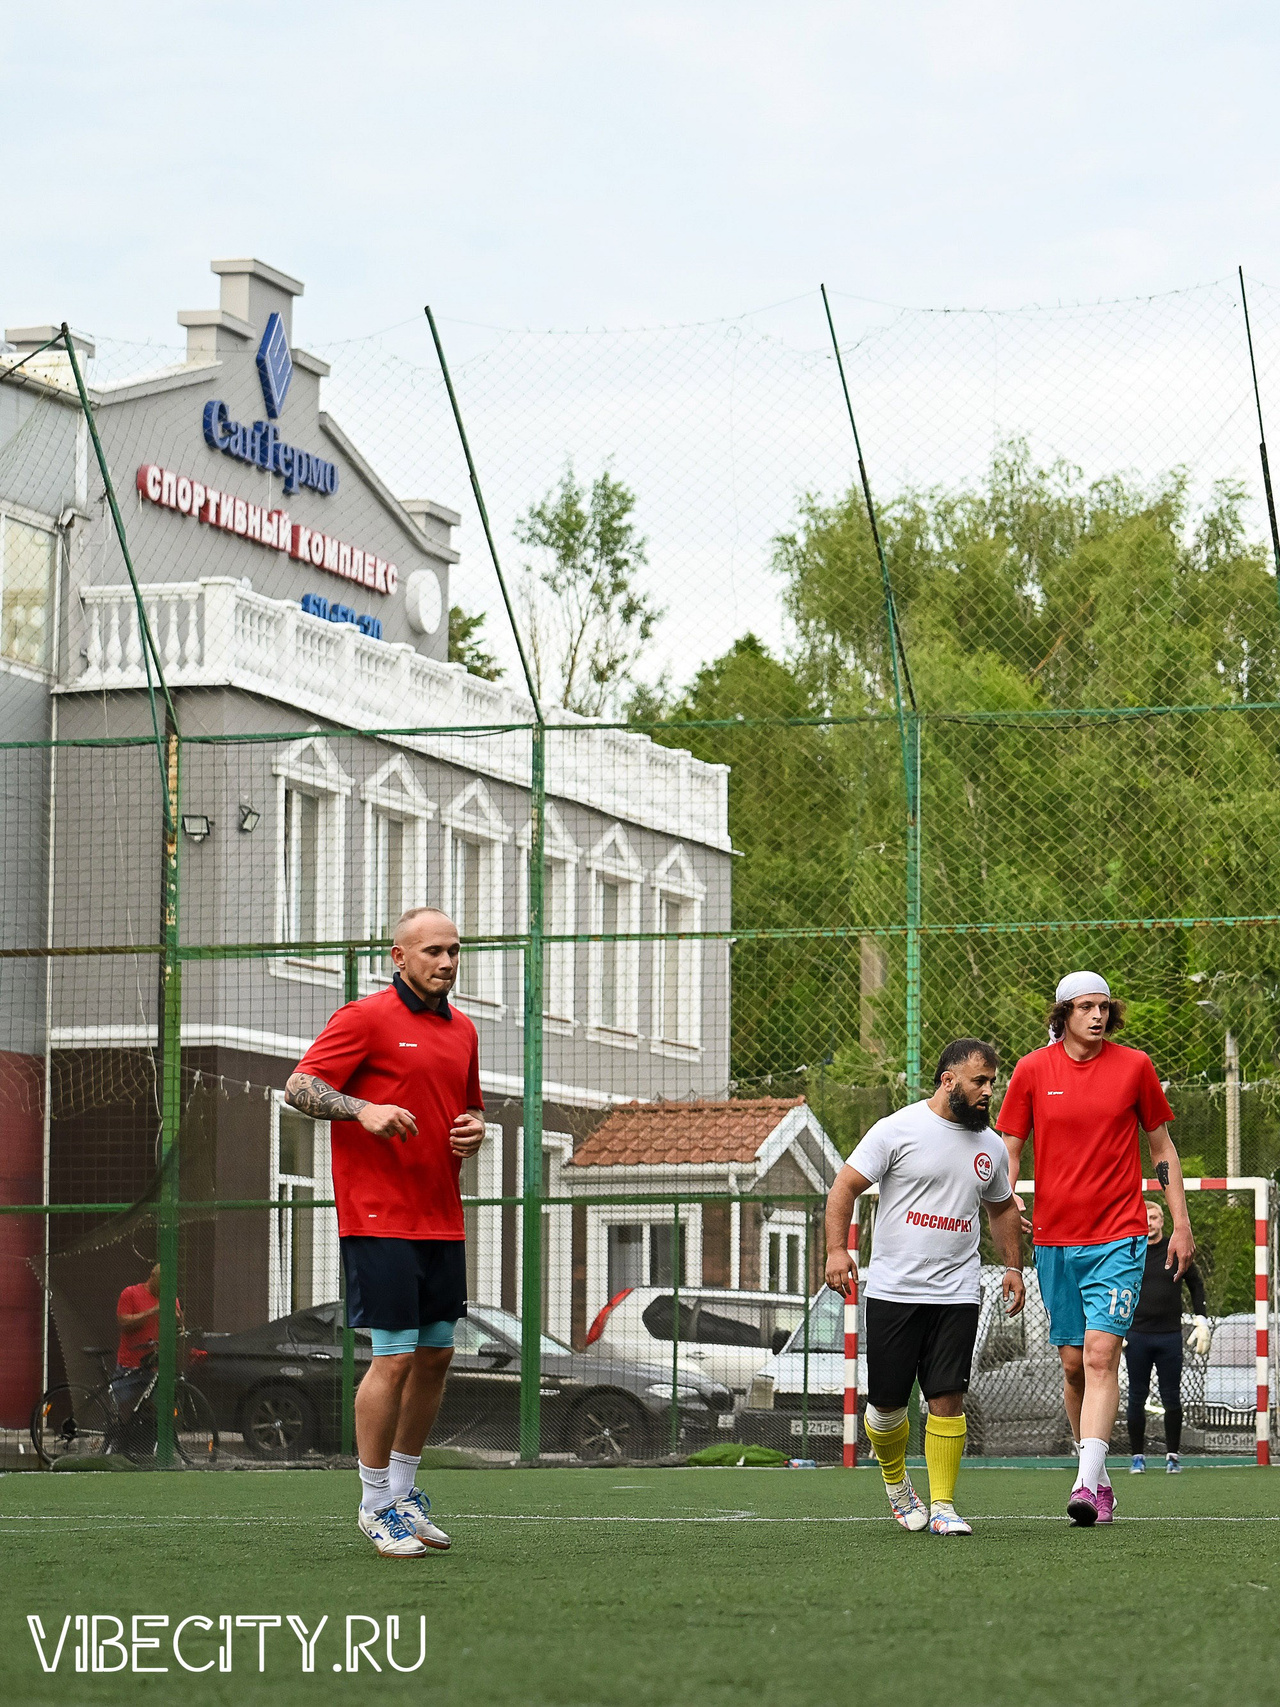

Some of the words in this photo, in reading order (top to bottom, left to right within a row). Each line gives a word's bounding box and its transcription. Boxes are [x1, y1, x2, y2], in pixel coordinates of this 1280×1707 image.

[205, 400, 340, 496] СанТермо
[143, 464, 292, 553] СПОРТИВНЫЙ
[295, 524, 399, 596] КОМПЛЕКС
[1108, 1287, 1132, 1319] 13
